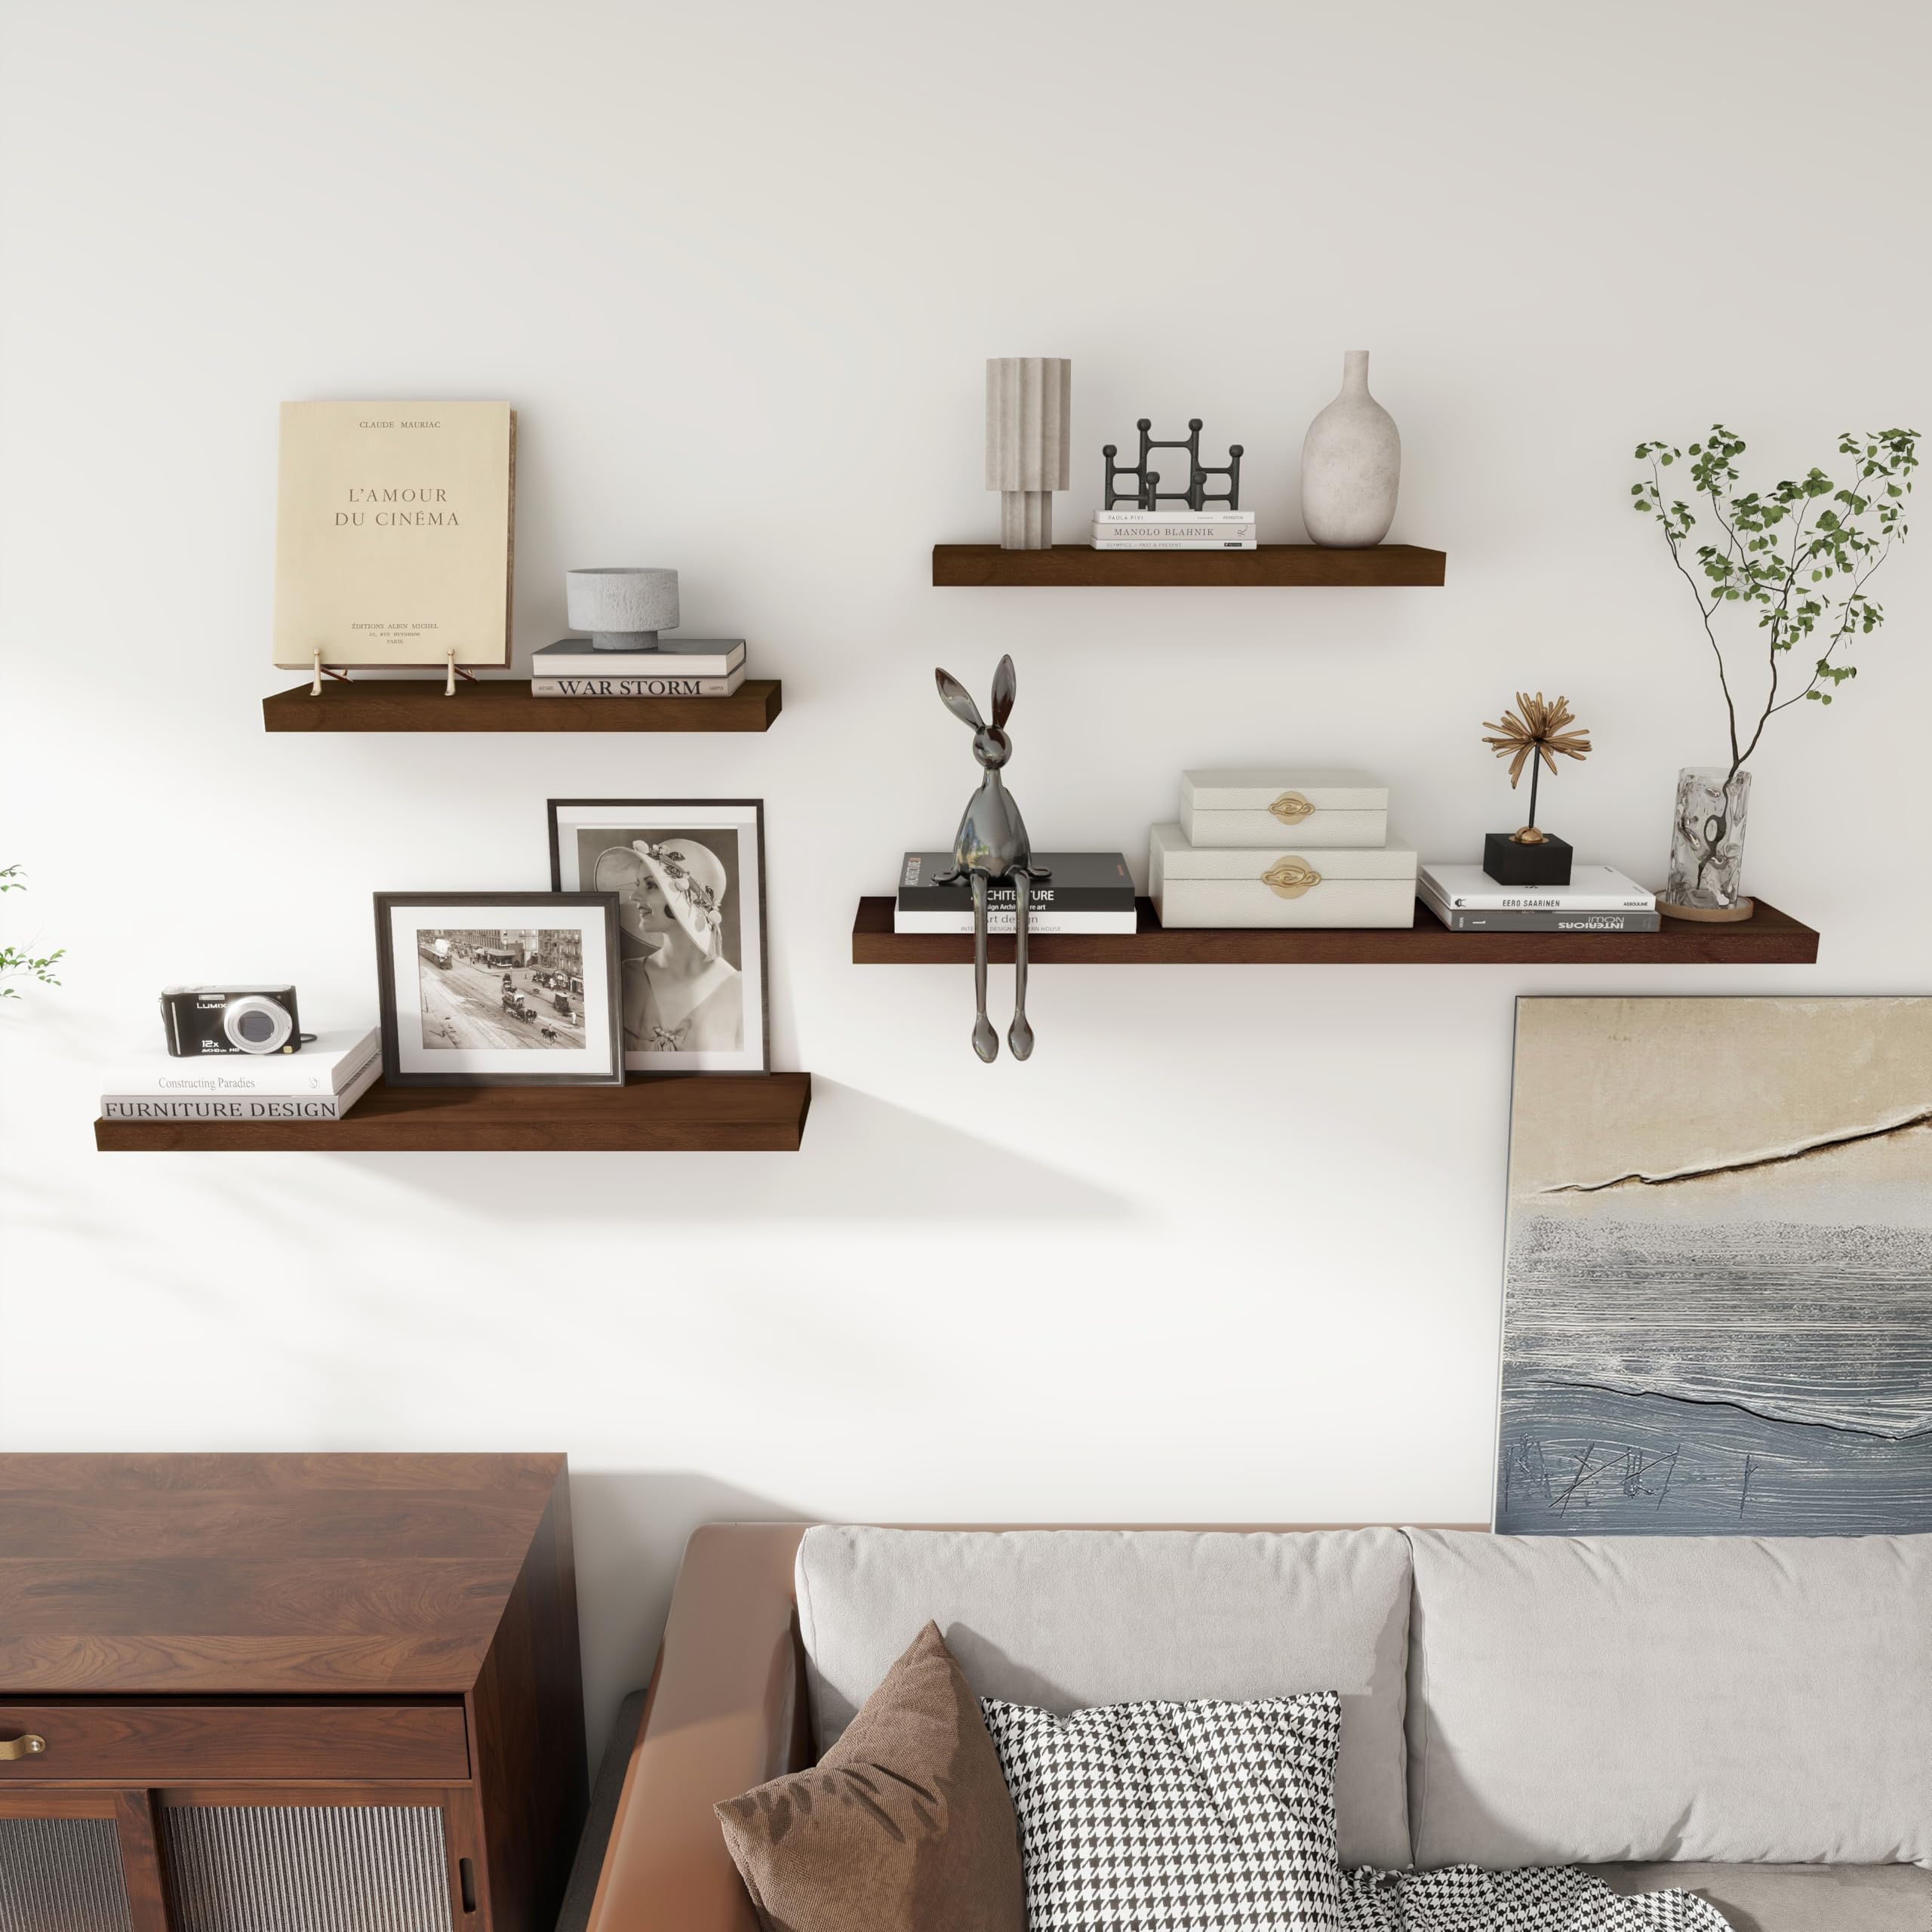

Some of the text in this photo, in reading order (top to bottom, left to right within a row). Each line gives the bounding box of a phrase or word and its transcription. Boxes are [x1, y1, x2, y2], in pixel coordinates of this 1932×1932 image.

[335, 510, 460, 526] DU CINÉMA
[557, 681, 703, 695] WAR STORM
[158, 1078, 256, 1090] Constructing Paradies
[105, 1103, 337, 1117] FURNITURE DESIGN
